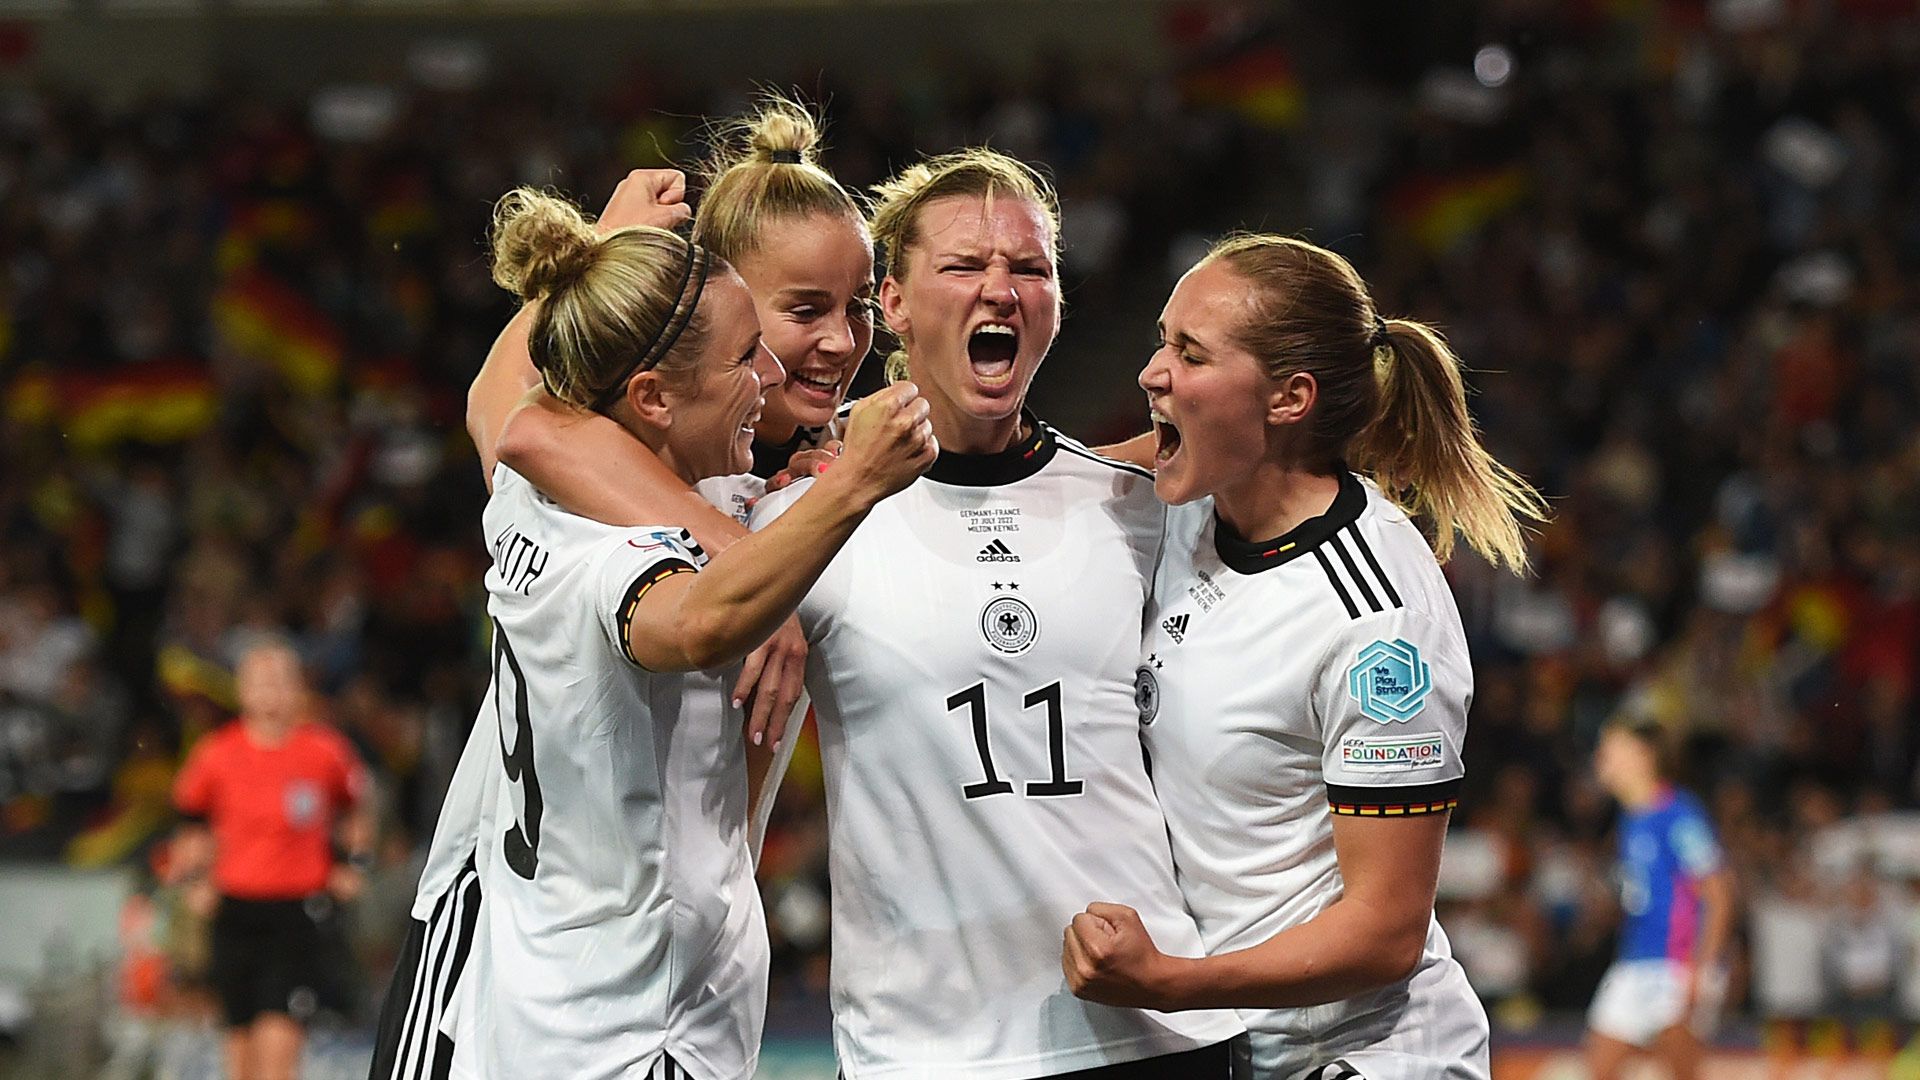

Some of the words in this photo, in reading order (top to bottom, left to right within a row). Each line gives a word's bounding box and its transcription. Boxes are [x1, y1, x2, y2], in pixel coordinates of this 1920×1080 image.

[960, 508, 1020, 517] GERMANY-FRANCE
[994, 524, 1019, 532] KEYNES
[976, 554, 1021, 562] adidas
[1375, 667, 1389, 675] We
[1375, 676, 1396, 686] Play
[1375, 686, 1408, 695] Strong
[946, 680, 1084, 800] 11
[1343, 739, 1365, 747] UEFA
[492, 615, 544, 881] 9
[1343, 744, 1441, 759] FOUNDATION
